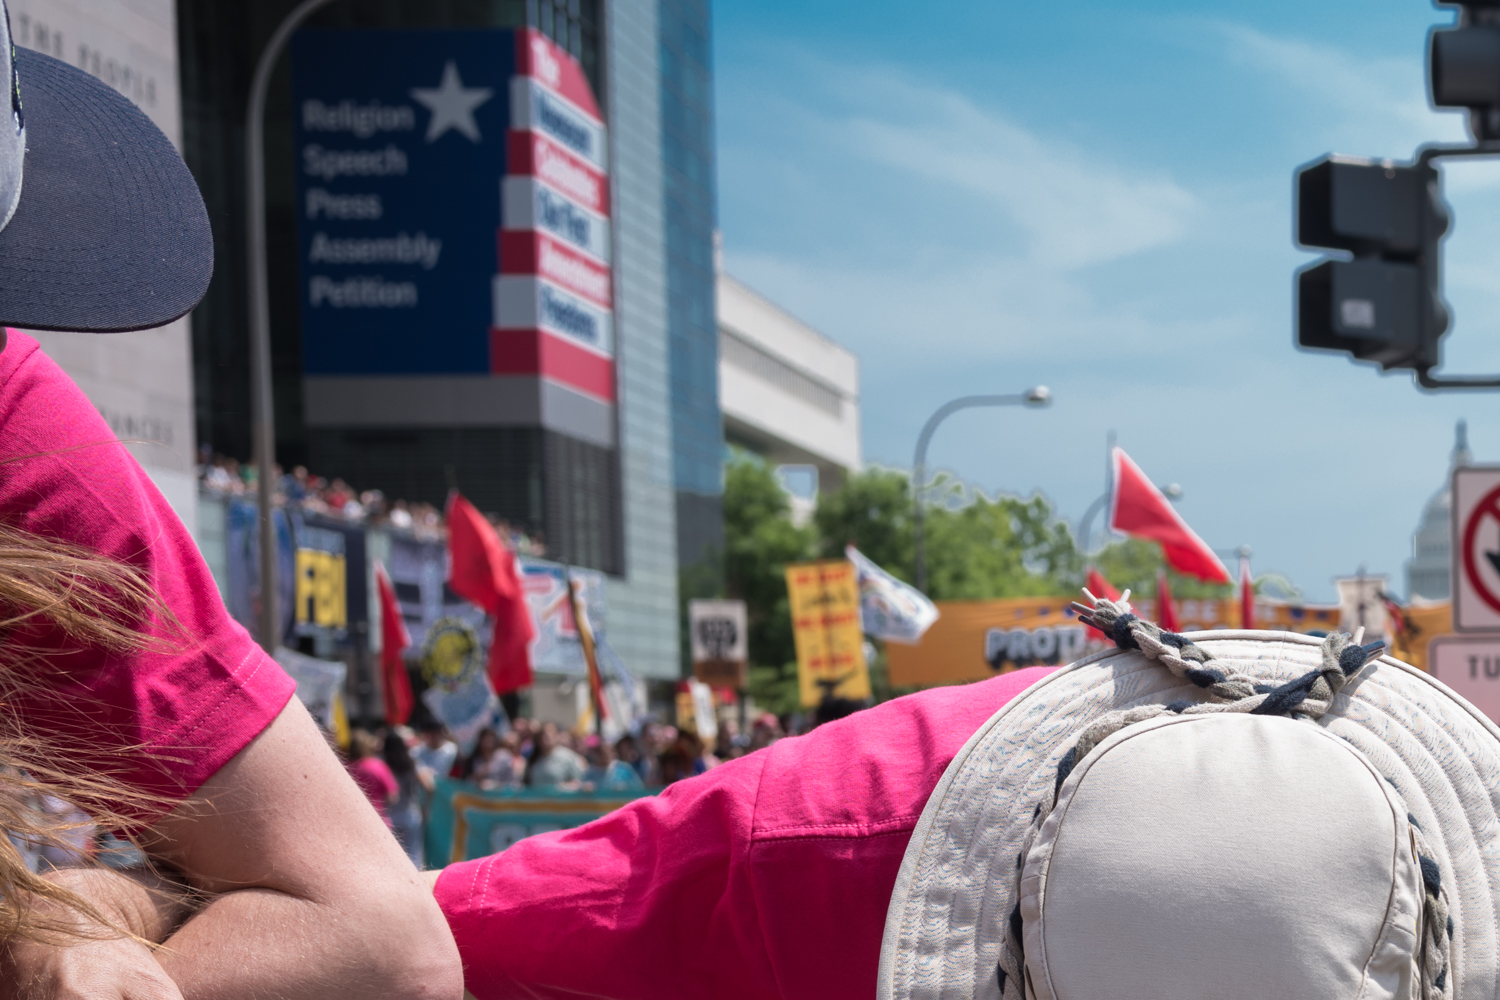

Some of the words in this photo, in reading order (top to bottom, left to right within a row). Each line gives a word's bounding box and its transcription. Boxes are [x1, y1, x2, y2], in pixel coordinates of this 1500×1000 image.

[303, 99, 415, 138] Religion
[303, 144, 408, 181] Speech
[305, 187, 383, 220] Press
[308, 231, 441, 270] Assembly
[308, 275, 418, 308] Petition
